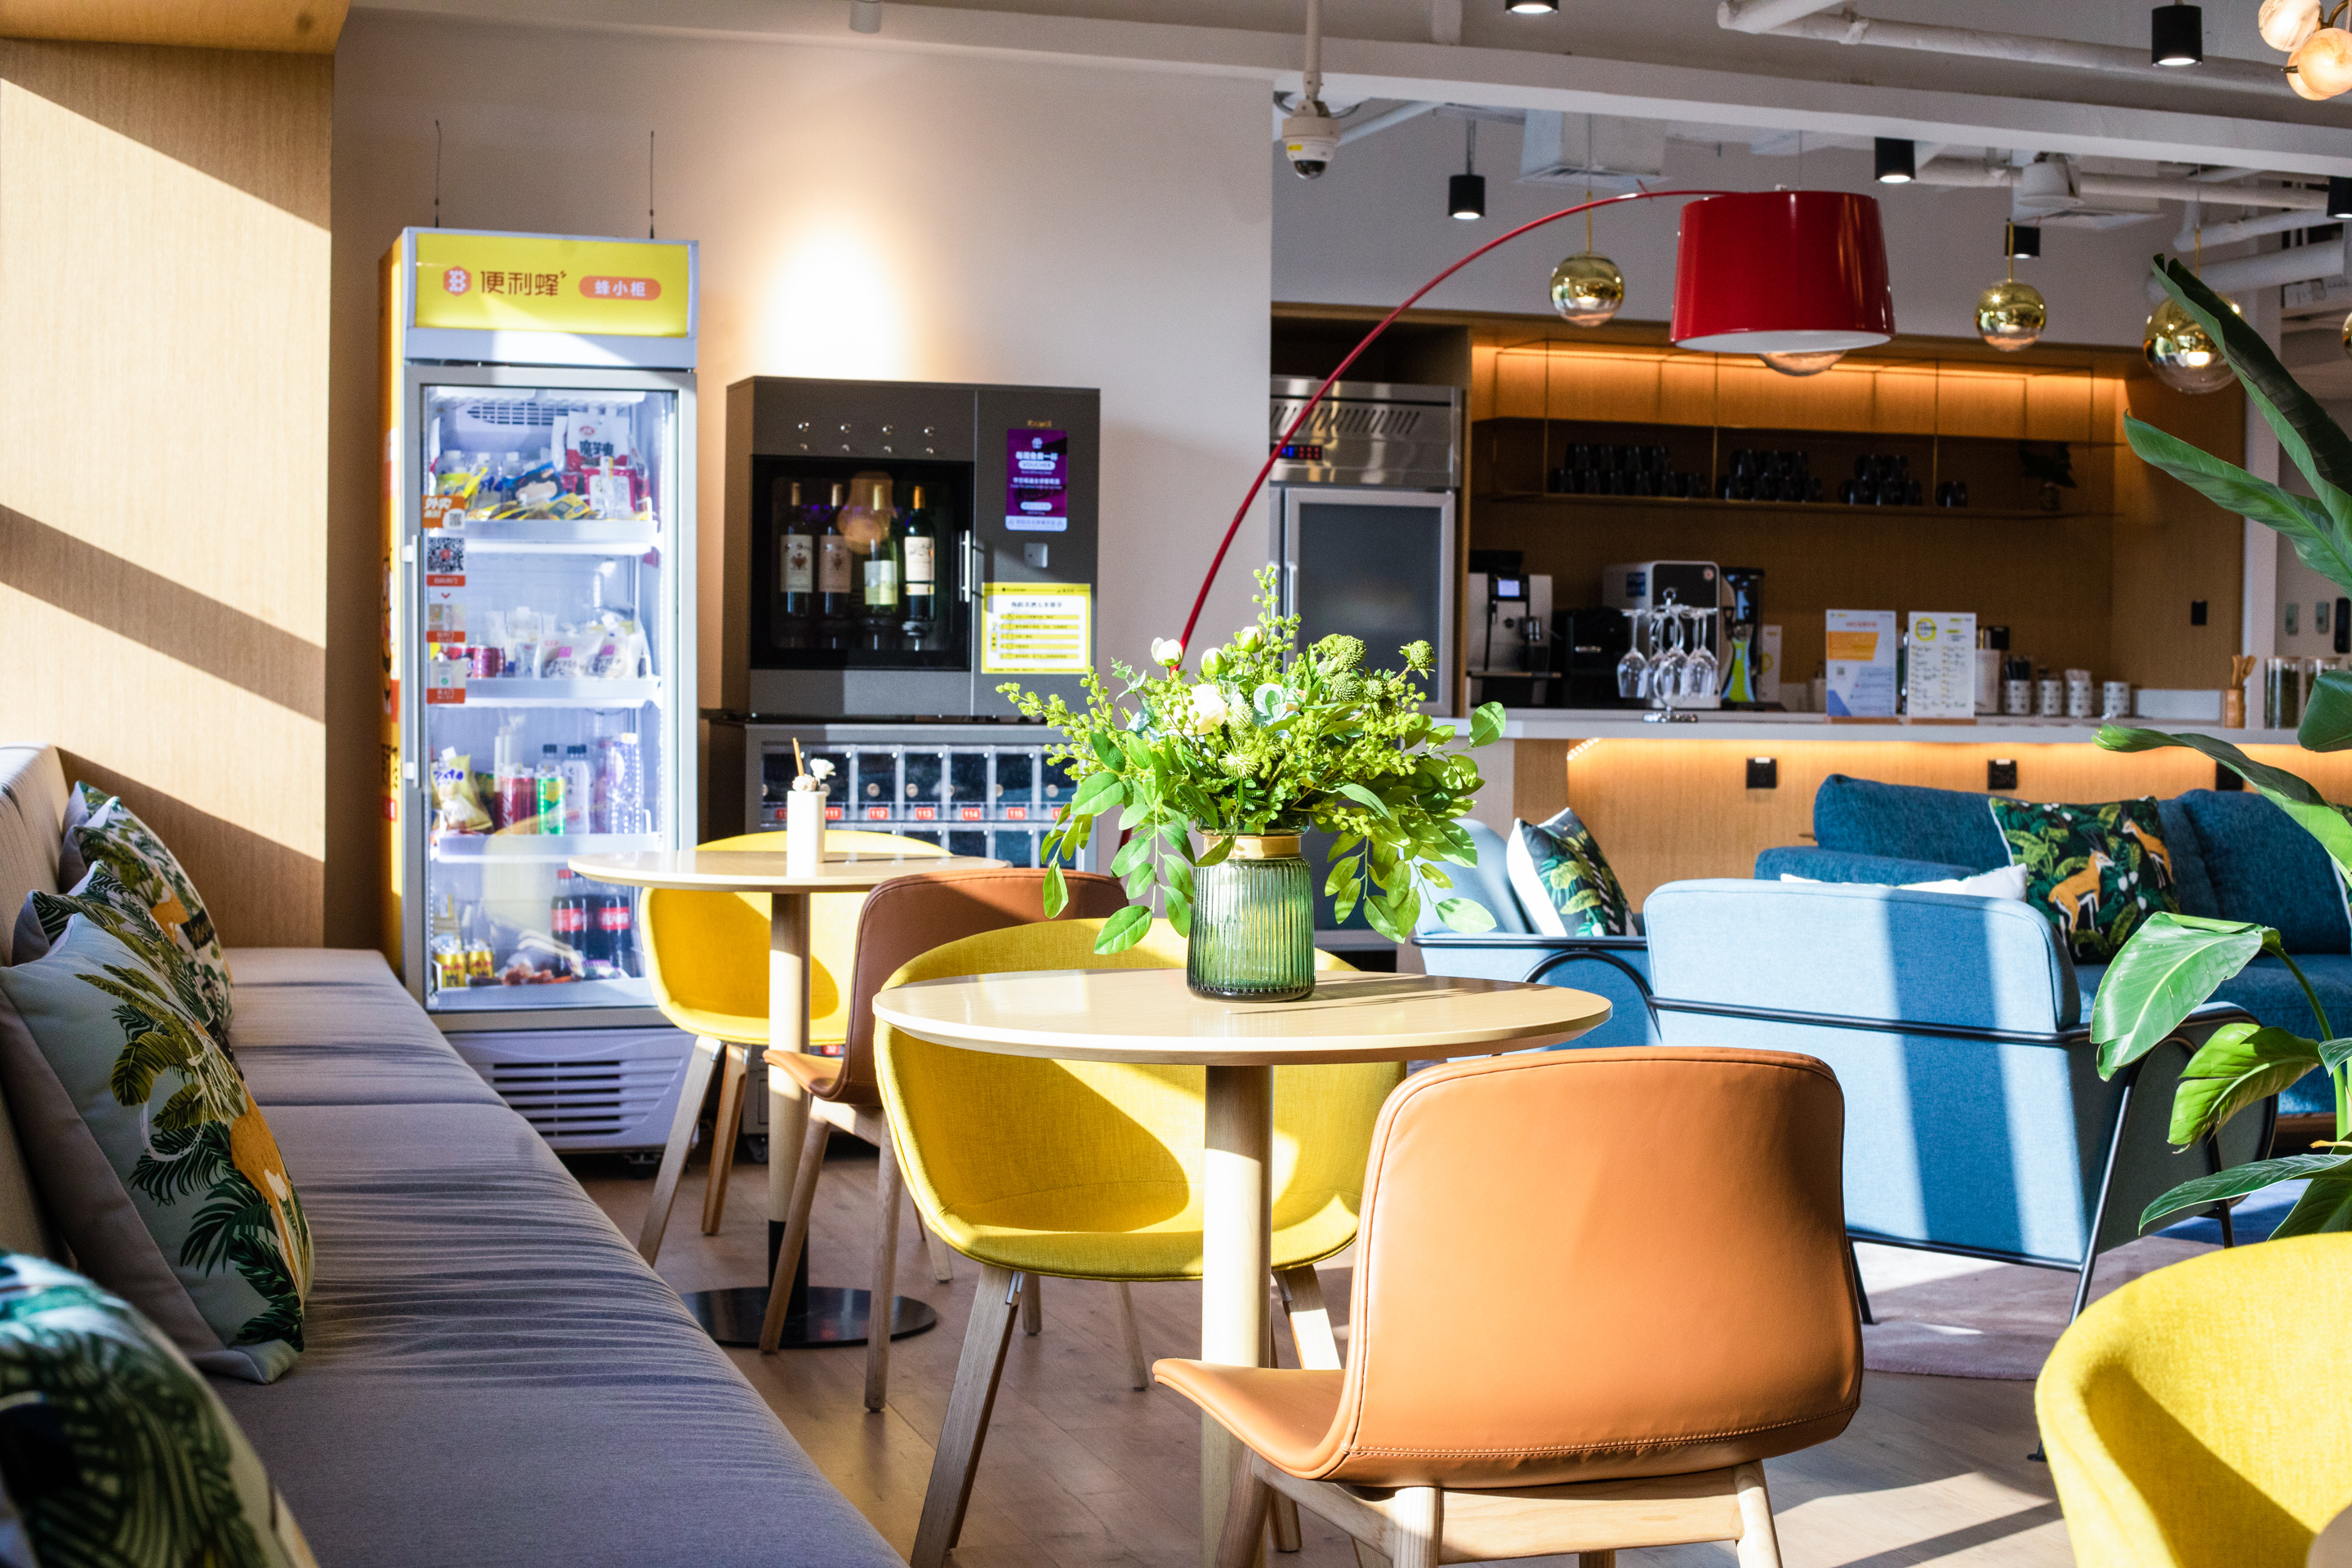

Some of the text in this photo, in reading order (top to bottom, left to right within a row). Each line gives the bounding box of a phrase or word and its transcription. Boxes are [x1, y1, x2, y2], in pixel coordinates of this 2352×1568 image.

[480, 271, 564, 296] 便利蜂
[595, 279, 646, 297] 蜂小柜
[871, 809, 886, 818] 112
[917, 809, 933, 818] 113
[964, 809, 979, 819] 114
[1009, 809, 1025, 818] 115
